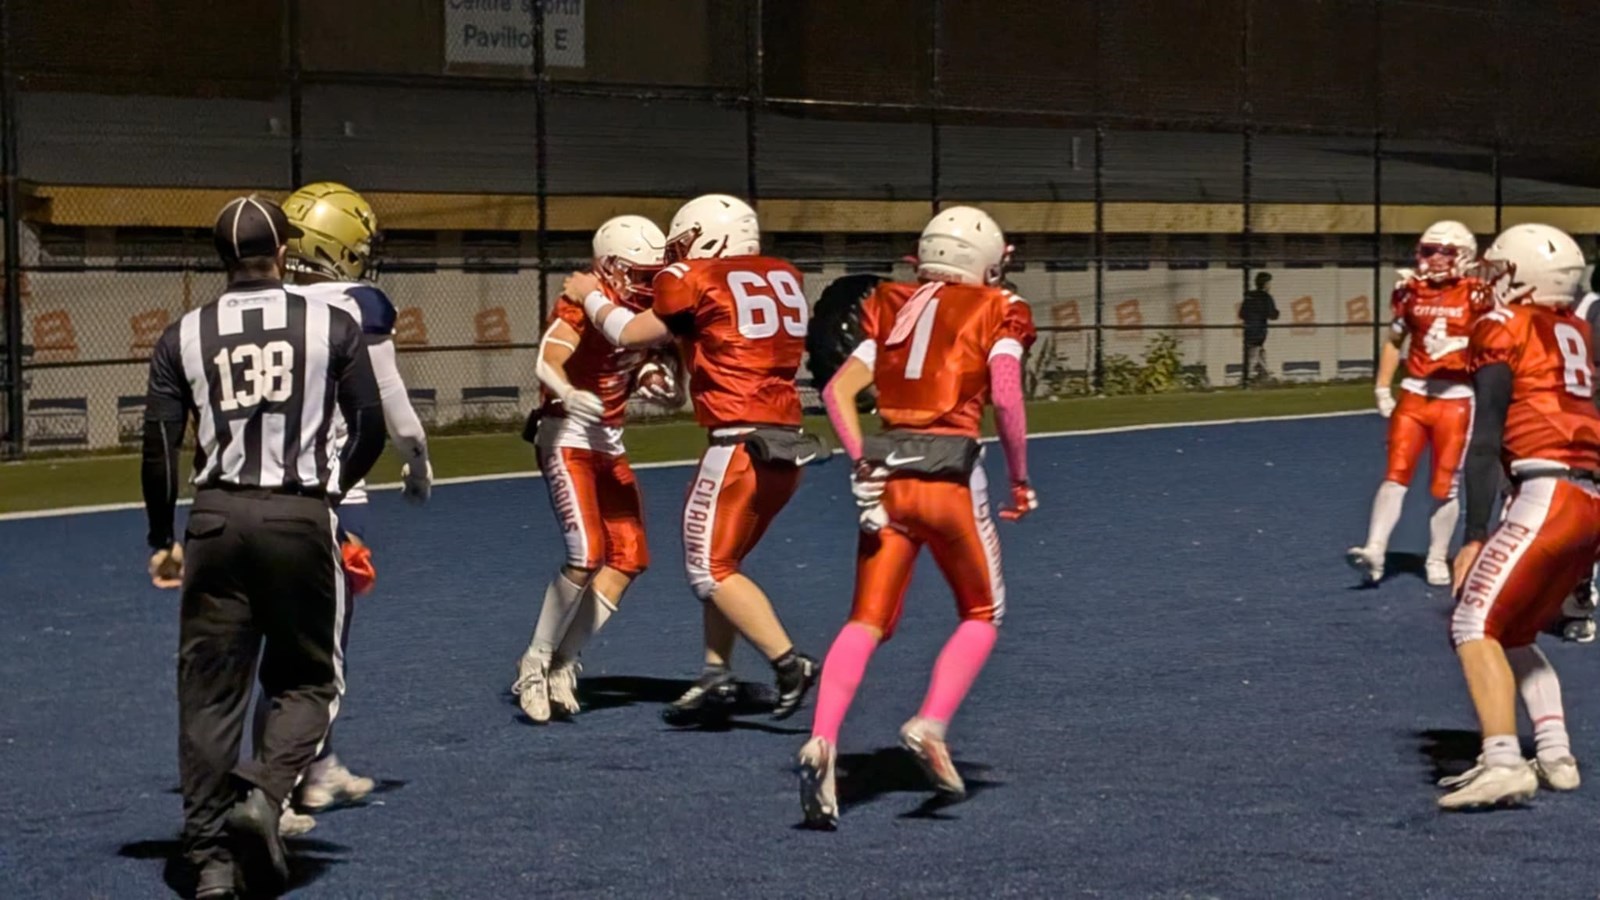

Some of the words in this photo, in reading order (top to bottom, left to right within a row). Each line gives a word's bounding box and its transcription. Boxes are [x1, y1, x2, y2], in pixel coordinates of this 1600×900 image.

[464, 24, 534, 49] Pavillo
[554, 28, 568, 50] E
[727, 270, 808, 339] 69
[905, 298, 939, 379] 1
[214, 341, 293, 411] 138
[1554, 322, 1592, 397] 8
[546, 453, 579, 533] CITADINS
[687, 478, 716, 569] CITADINS
[1464, 522, 1530, 609] CITADINS
